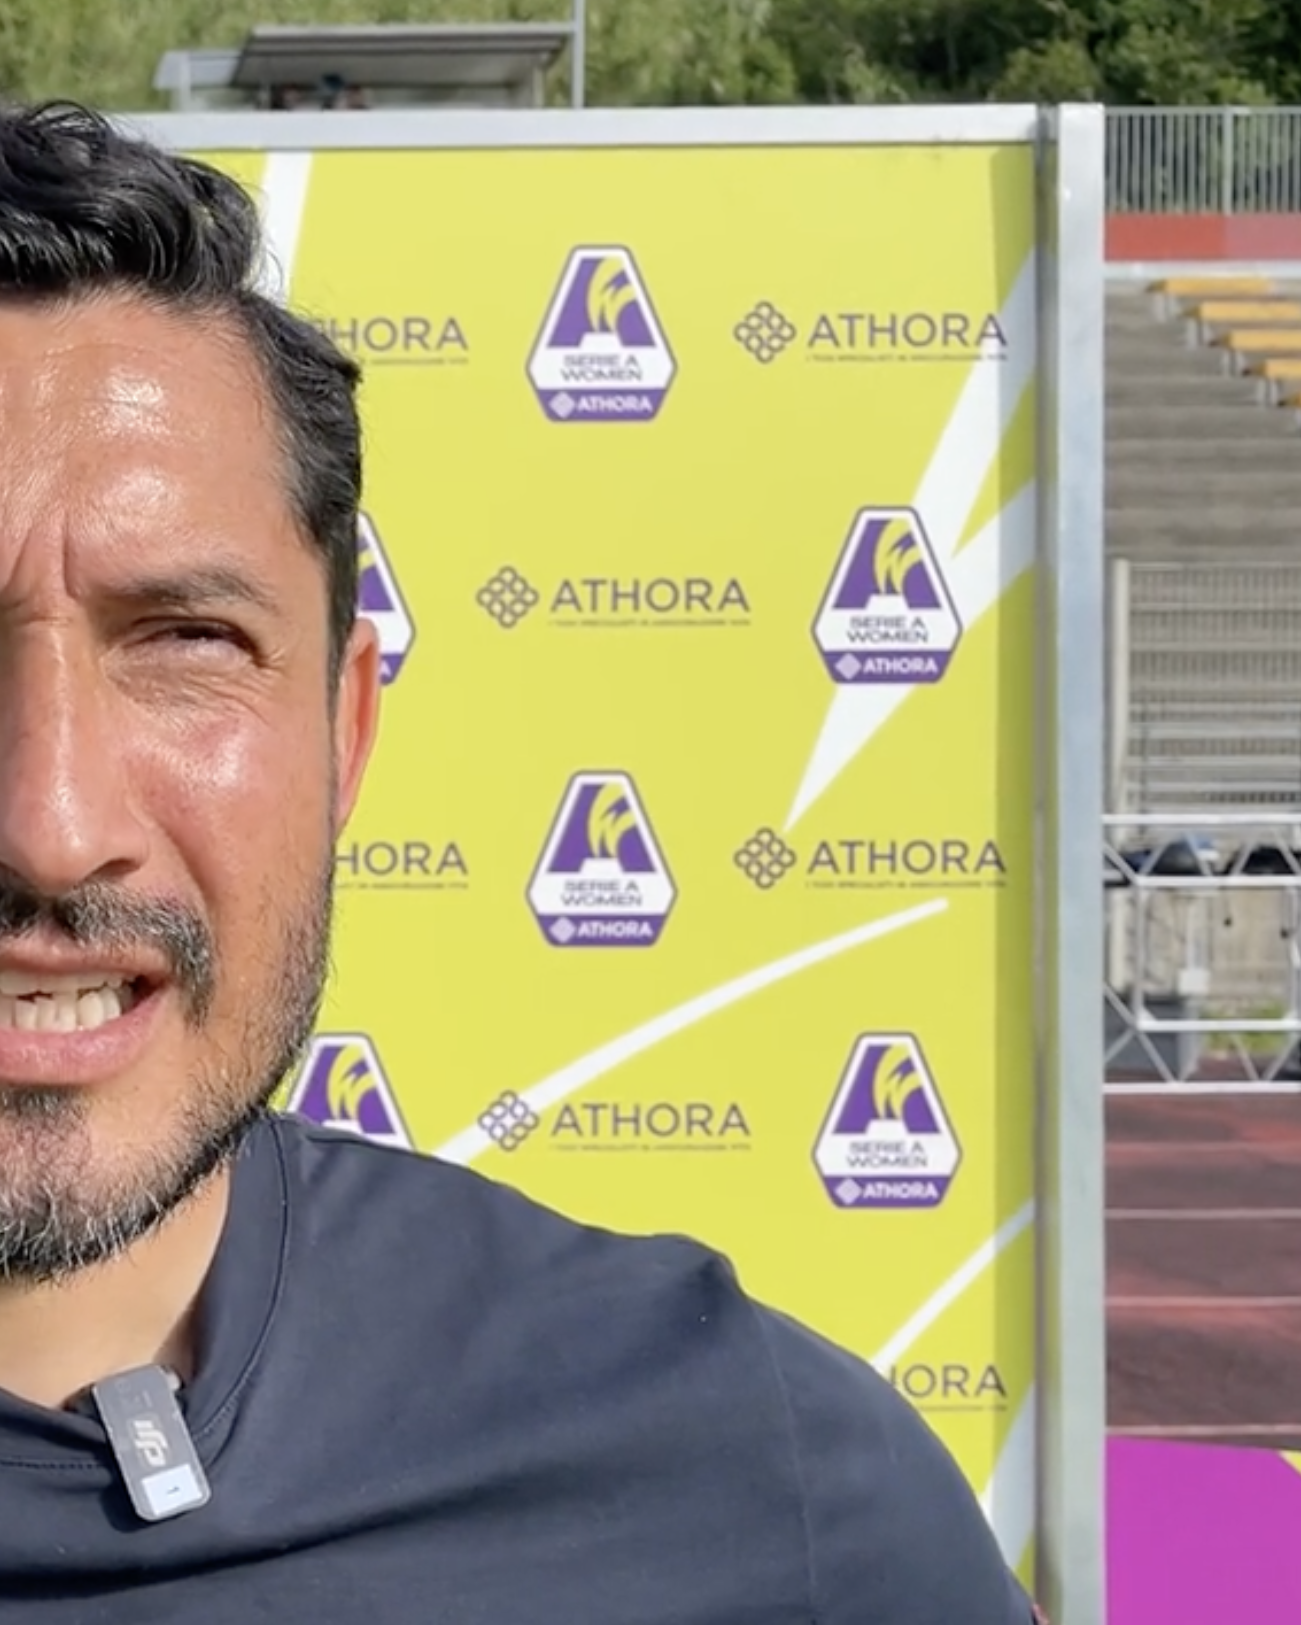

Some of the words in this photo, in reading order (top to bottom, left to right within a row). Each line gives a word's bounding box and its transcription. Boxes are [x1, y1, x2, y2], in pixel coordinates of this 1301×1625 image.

[327, 316, 468, 352] HORA
[807, 313, 1008, 348] ATHORA
[564, 354, 619, 365] SERIE
[560, 367, 642, 380] WOMEN
[577, 396, 652, 412] ATHORA
[550, 577, 750, 612] ATHORA
[850, 616, 905, 627] SERIE
[846, 629, 928, 642] WOMEN
[862, 658, 938, 674] ATHORA
[335, 841, 468, 876] HORA
[807, 840, 1007, 875] ATHORA
[565, 880, 620, 891] SERIE
[561, 893, 642, 906] WOMEN
[577, 921, 652, 937] ATHORA
[551, 1103, 751, 1137] ATHORA
[850, 1141, 905, 1152] SERIE
[847, 1154, 928, 1167] WOMEN
[863, 1183, 938, 1199] ATHORA
